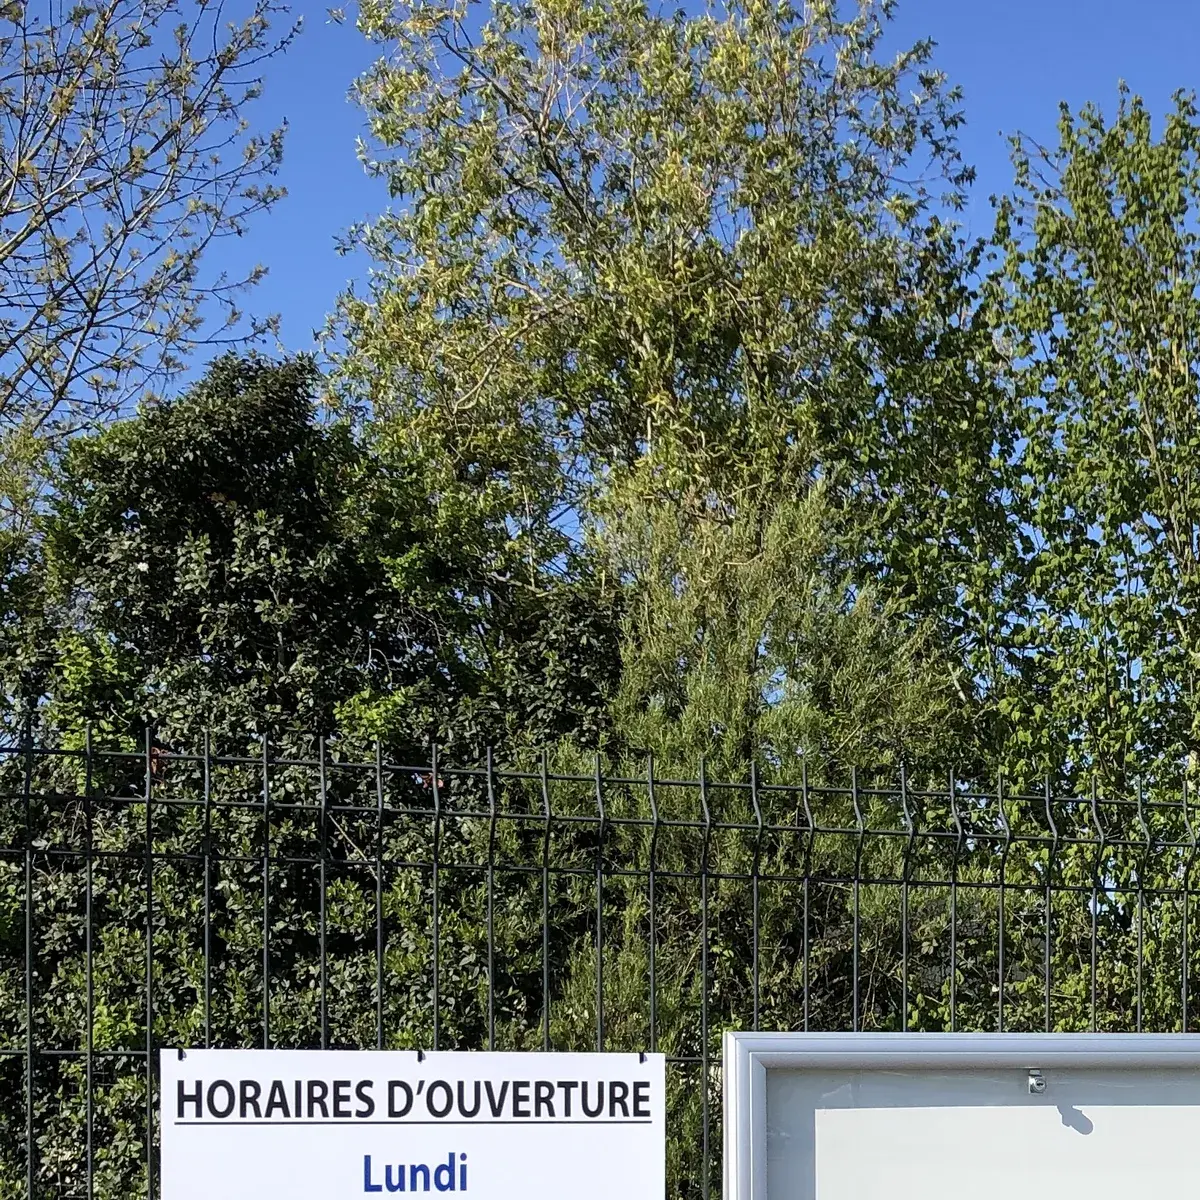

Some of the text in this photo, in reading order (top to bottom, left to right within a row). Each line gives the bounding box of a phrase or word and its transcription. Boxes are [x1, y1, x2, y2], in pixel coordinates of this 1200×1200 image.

[176, 1078, 652, 1119] HORAIRES D’OUVERTURE
[363, 1152, 469, 1193] Lundi
